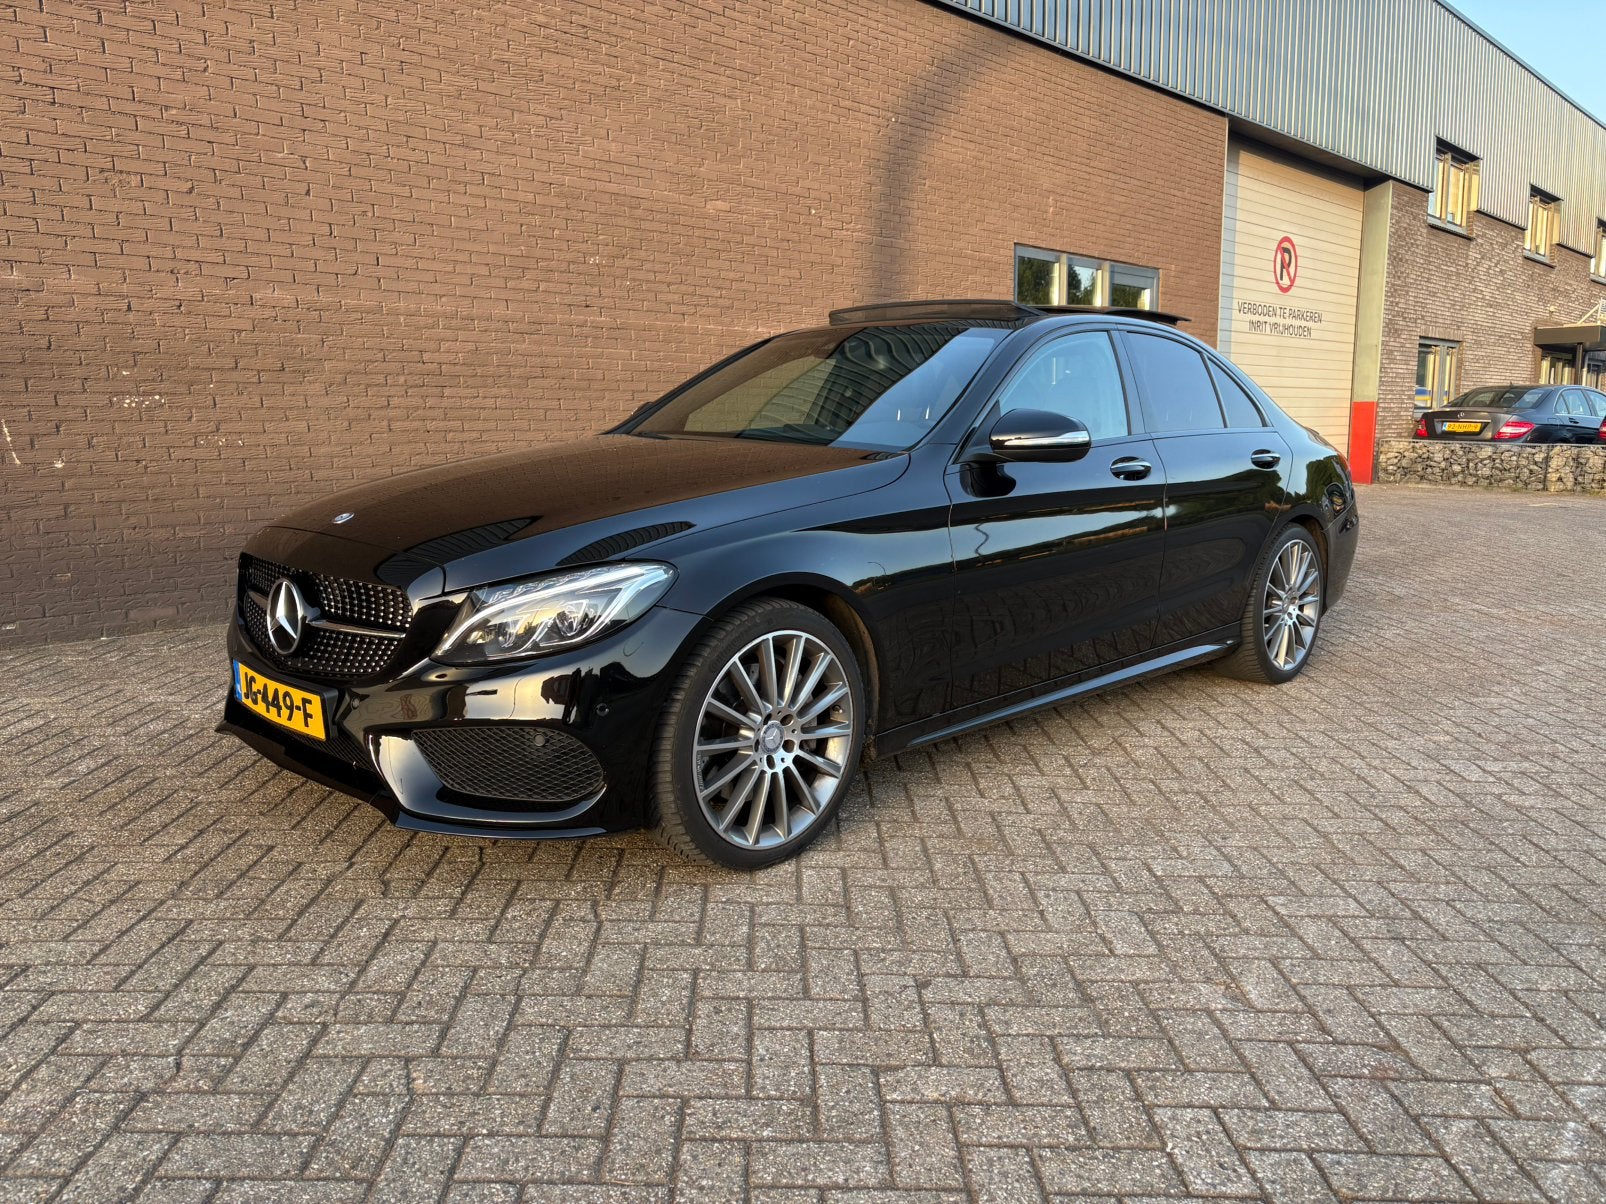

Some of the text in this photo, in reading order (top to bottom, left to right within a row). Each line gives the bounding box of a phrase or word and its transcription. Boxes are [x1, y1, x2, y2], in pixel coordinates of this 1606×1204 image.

[1279, 246, 1292, 281] P
[1238, 301, 1322, 324] VERBODEN TE PARKEREN
[1249, 319, 1268, 333] INRIT
[243, 671, 314, 728] JG-449-F
